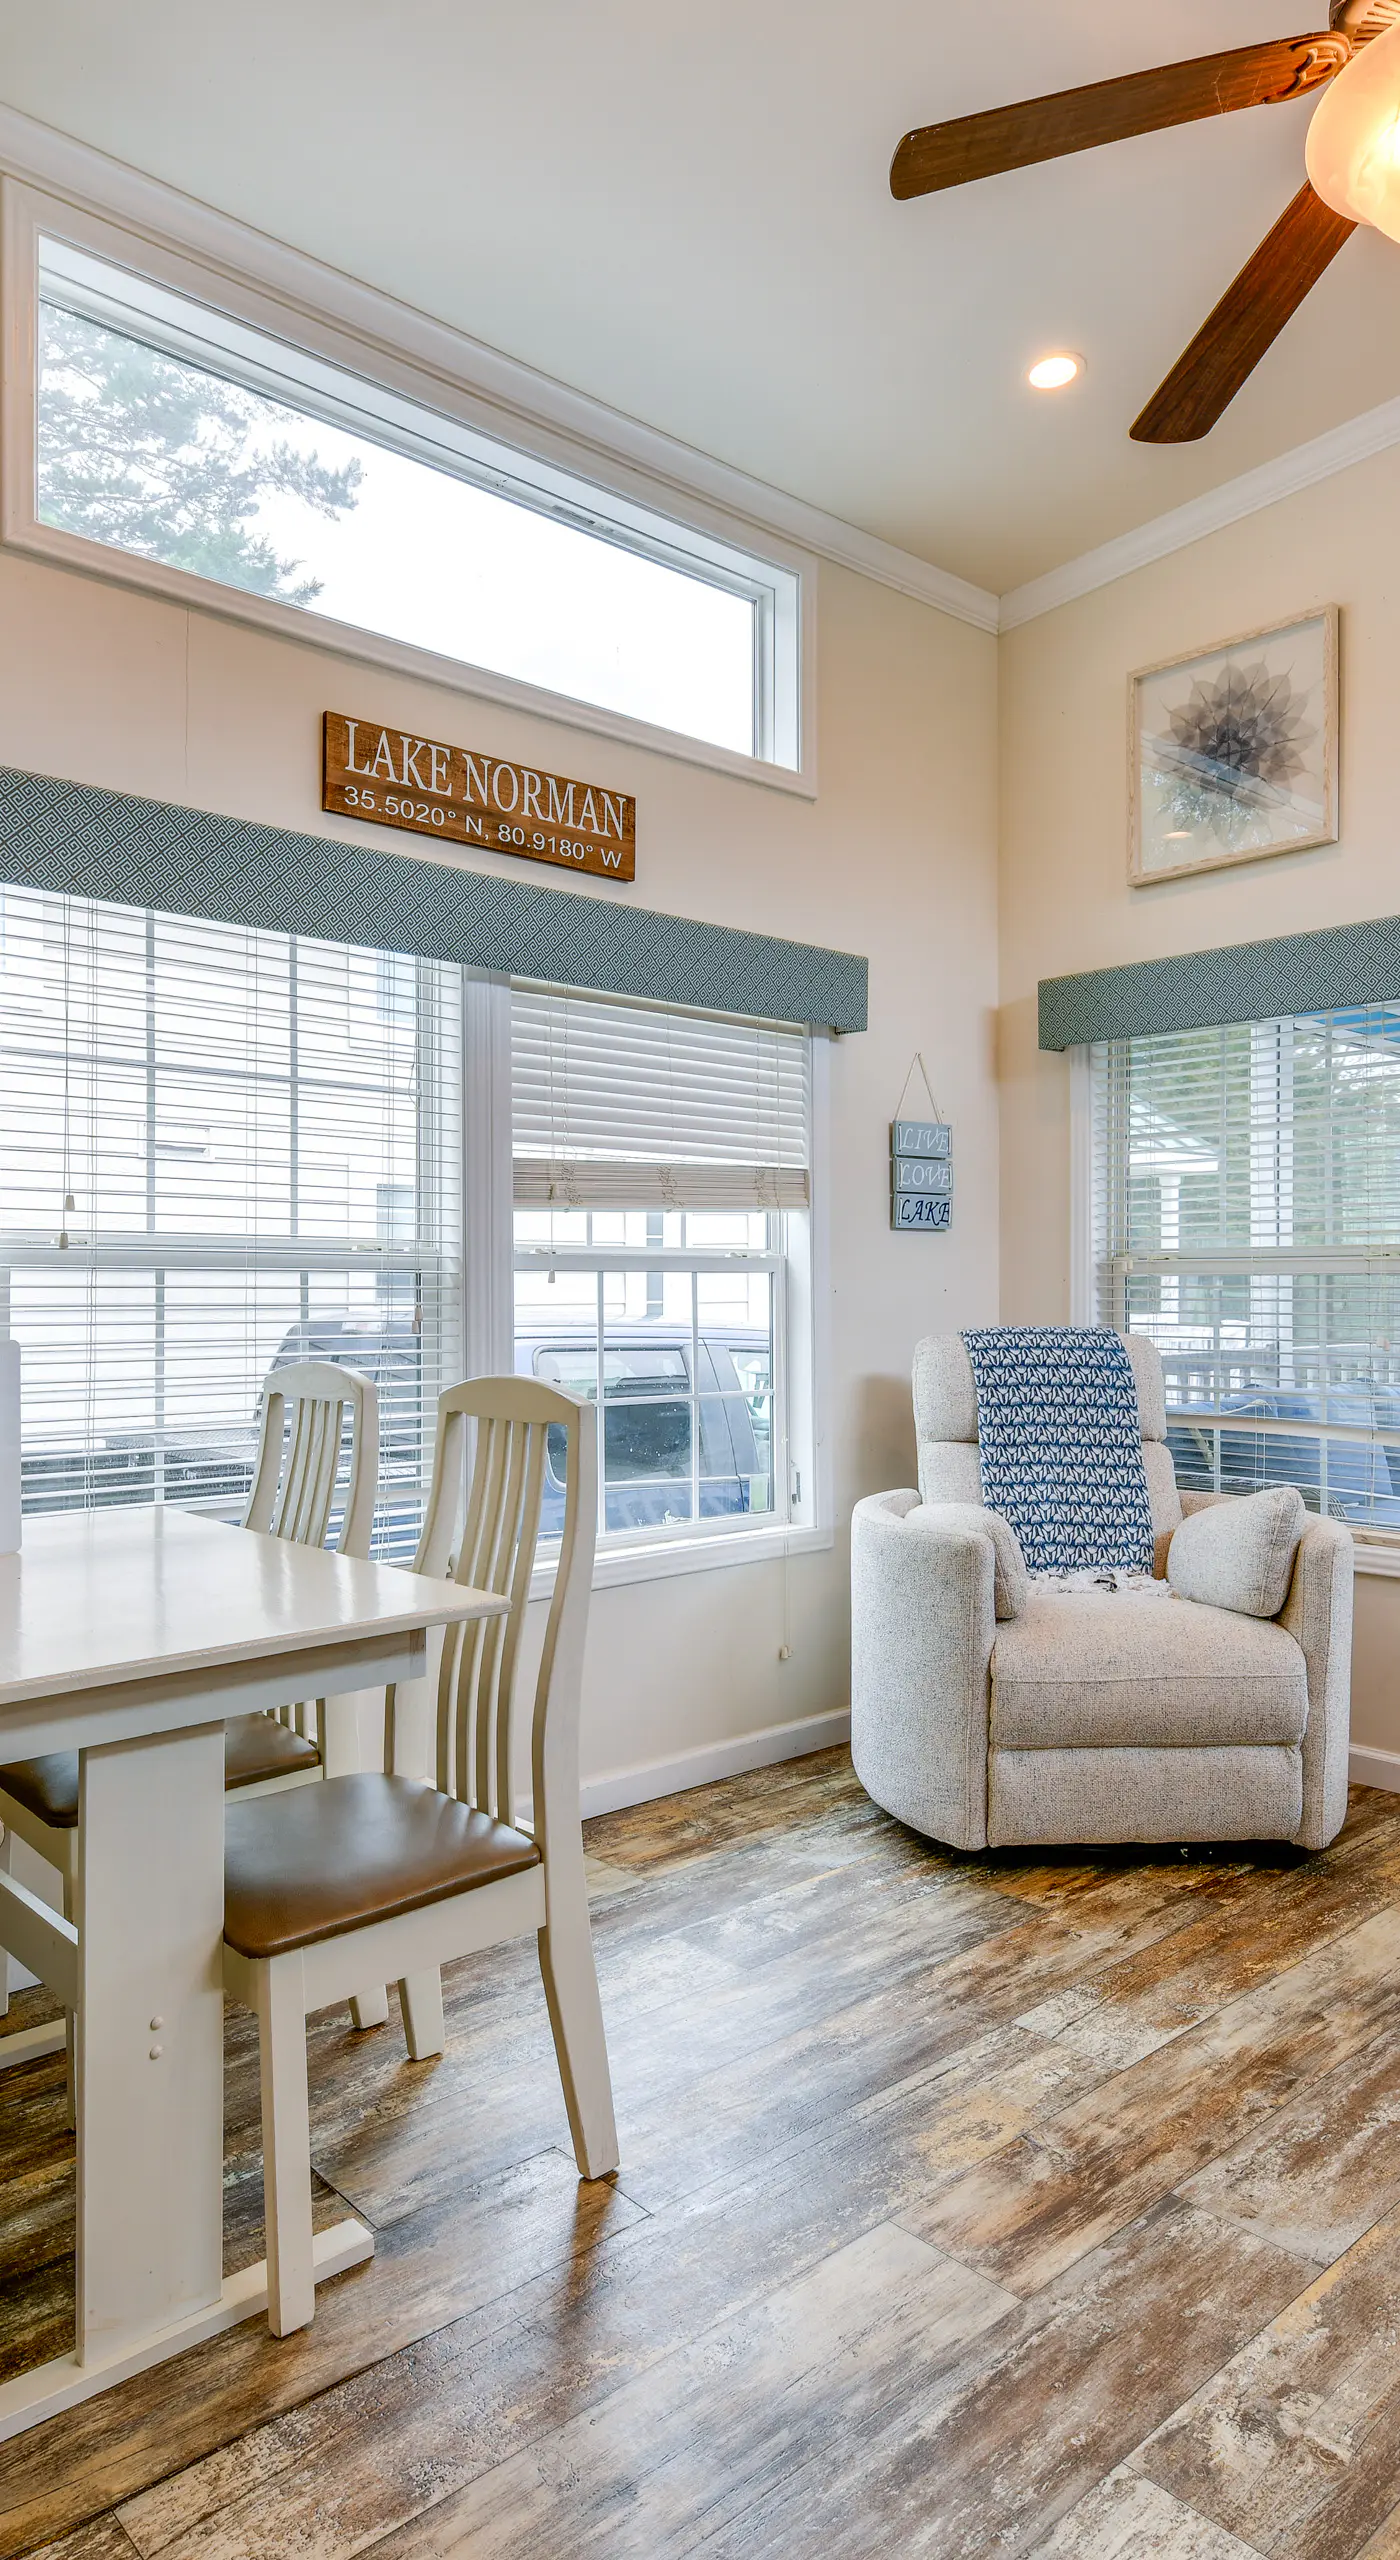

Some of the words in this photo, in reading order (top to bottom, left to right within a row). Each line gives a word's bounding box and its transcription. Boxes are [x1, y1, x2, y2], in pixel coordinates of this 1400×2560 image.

[344, 720, 452, 797] LAKE
[462, 753, 627, 841] NORMAN
[343, 786, 457, 827] 35.5020°
[465, 815, 490, 841] N,
[498, 824, 594, 860] 80.9180°
[601, 848, 622, 869] W
[901, 1127, 949, 1152] LIVE
[900, 1163, 950, 1188] LOVE
[901, 1199, 950, 1226] LAKE
